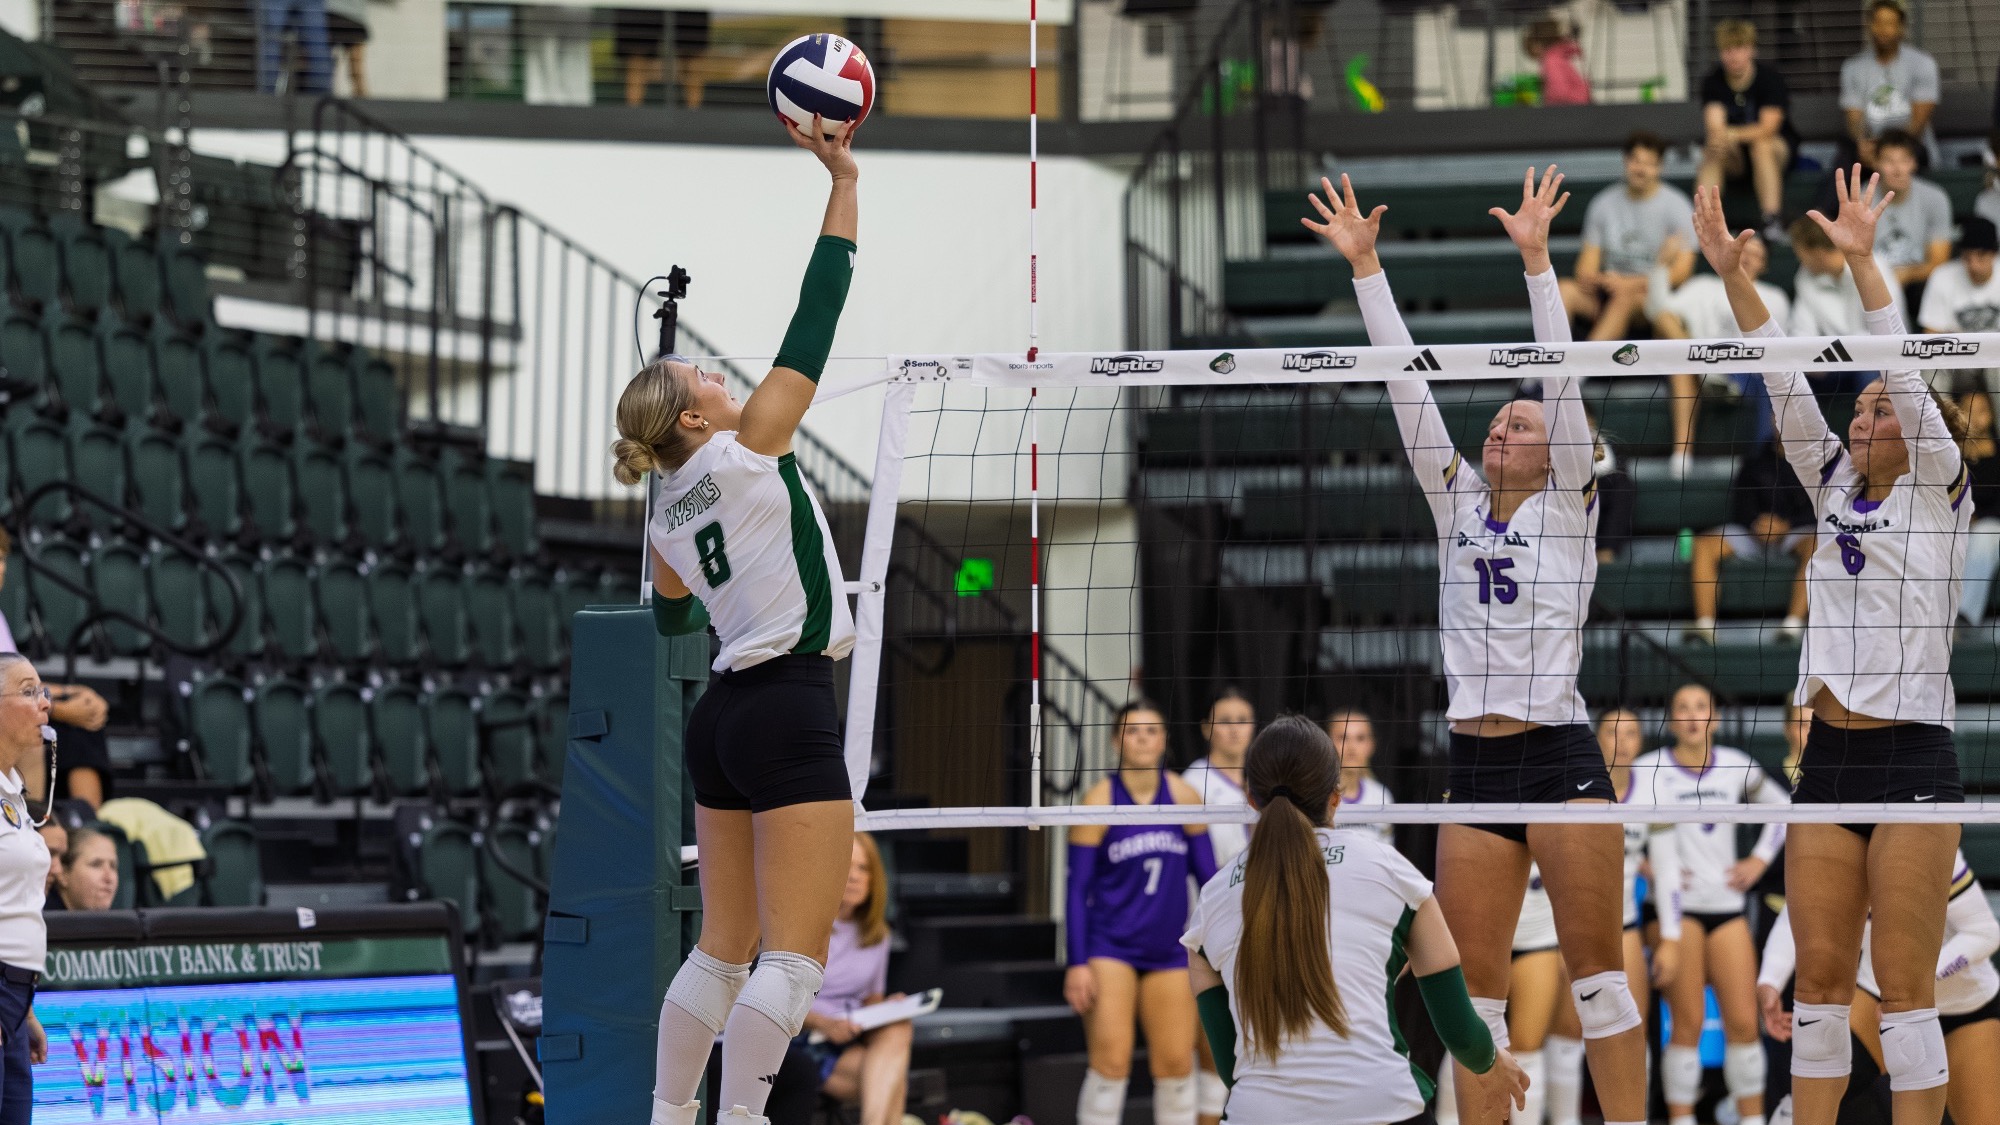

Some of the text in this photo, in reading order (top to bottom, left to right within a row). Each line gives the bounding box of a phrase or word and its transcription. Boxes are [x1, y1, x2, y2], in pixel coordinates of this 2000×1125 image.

[911, 360, 940, 368] Senoh
[1090, 355, 1164, 376] Mystics
[1282, 351, 1357, 373] Mystics
[1489, 346, 1564, 368] Mystics
[1688, 342, 1765, 362] Mystics
[1902, 337, 1979, 359] Mystics
[665, 473, 722, 534] MYSTICS
[694, 520, 732, 590] 8
[1835, 532, 1866, 576] 6
[1473, 557, 1519, 605] 15
[1142, 857, 1163, 896] 7
[43, 940, 323, 981] COMMUNITY BANK & TRUST
[64, 1004, 310, 1119] VISION
